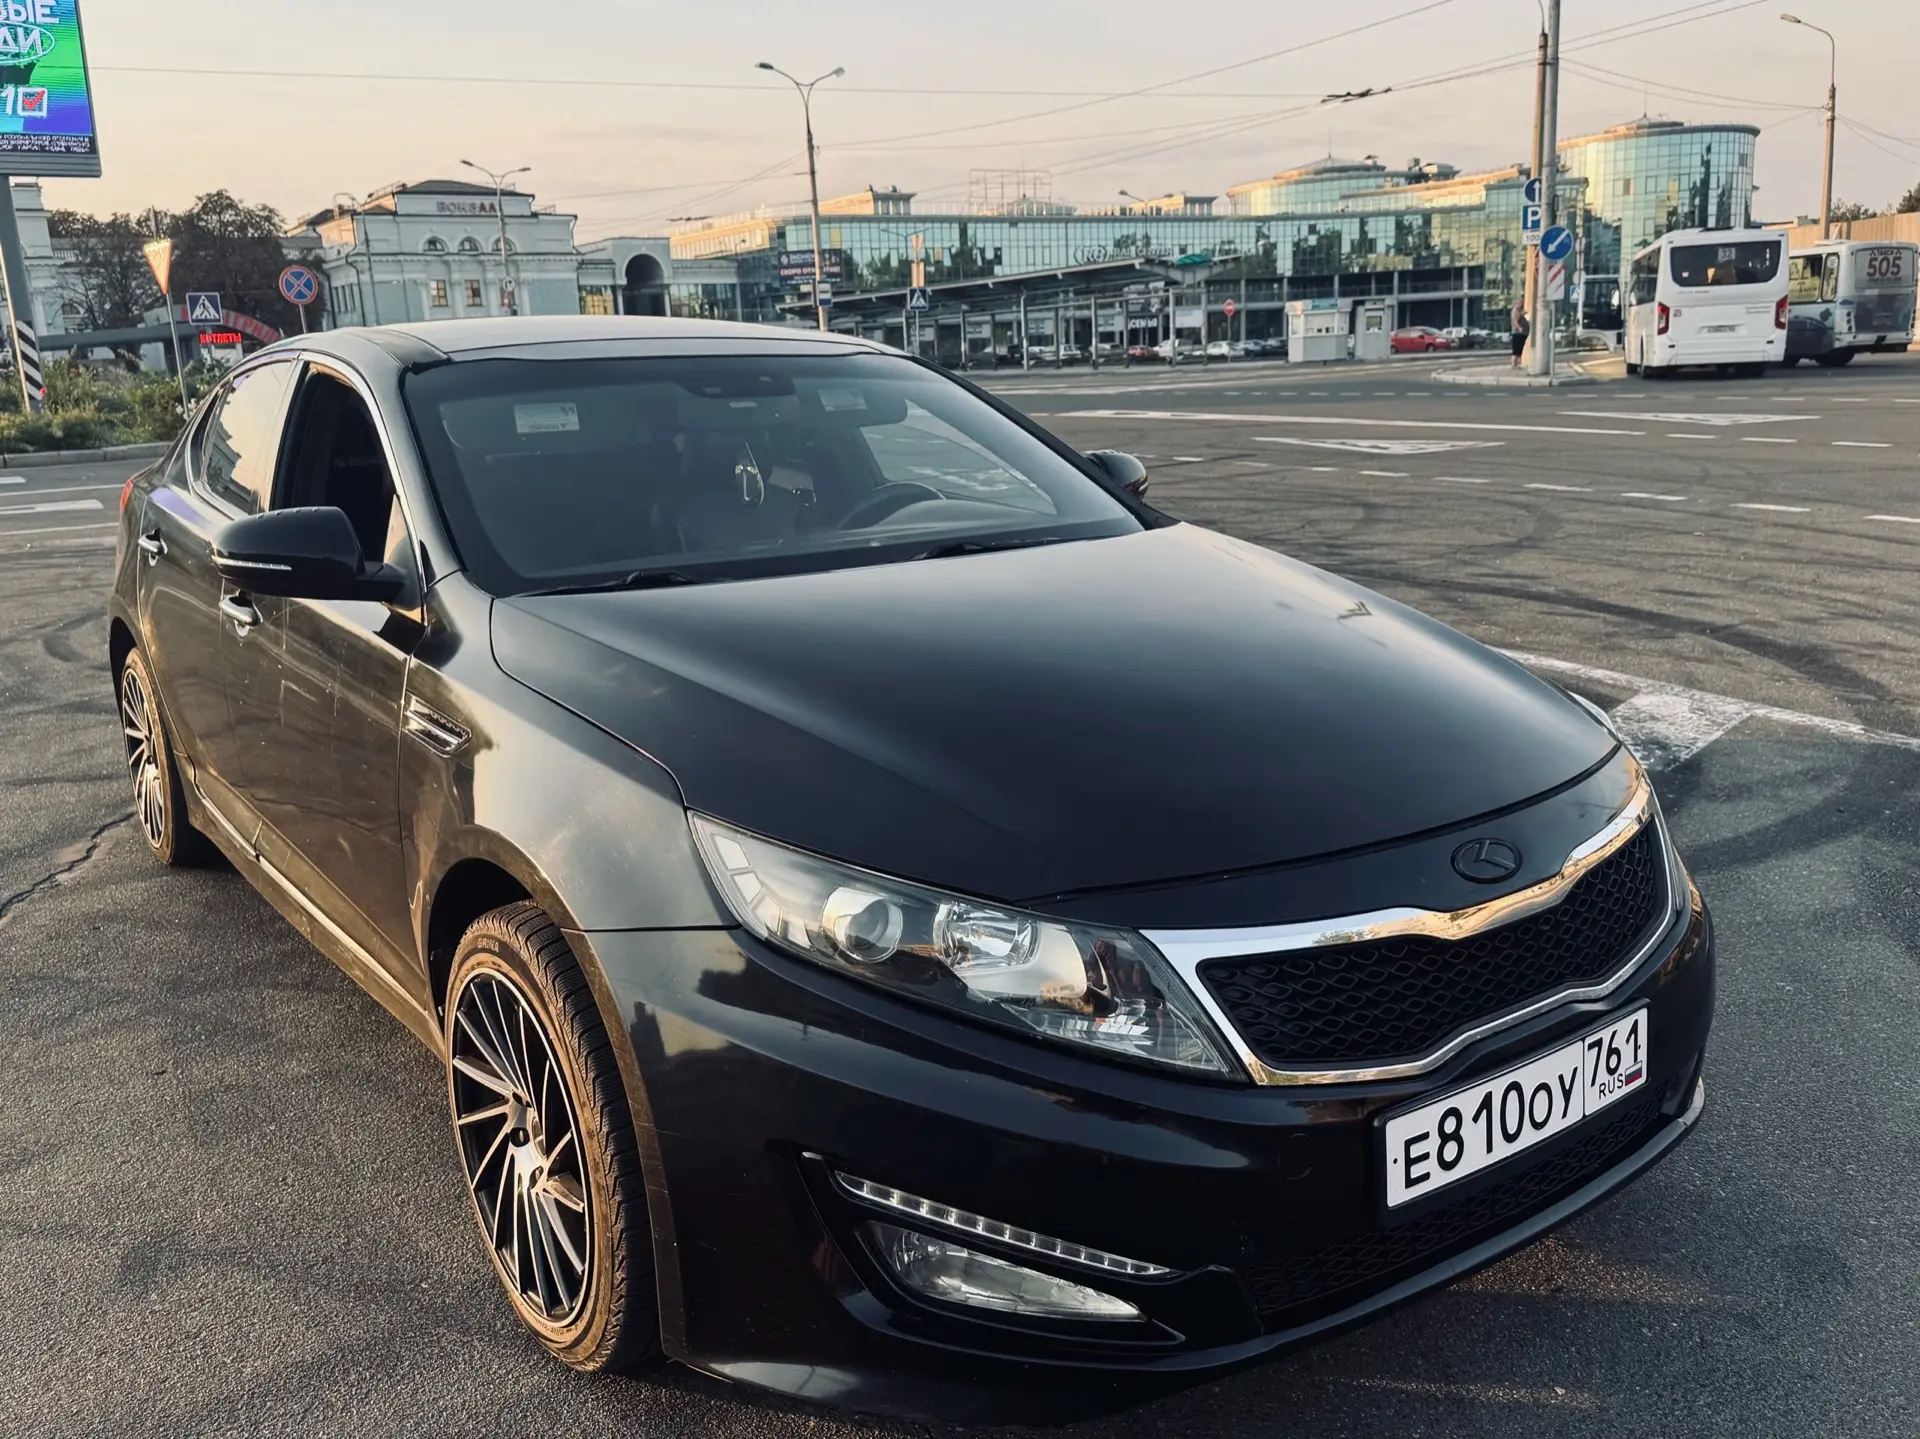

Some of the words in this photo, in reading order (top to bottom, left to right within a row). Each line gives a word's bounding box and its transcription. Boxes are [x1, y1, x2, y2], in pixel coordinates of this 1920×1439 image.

[1527, 206, 1541, 228] P
[1867, 256, 1902, 277] 505
[1586, 1018, 1640, 1087] 761
[1598, 1077, 1624, 1100] RUS
